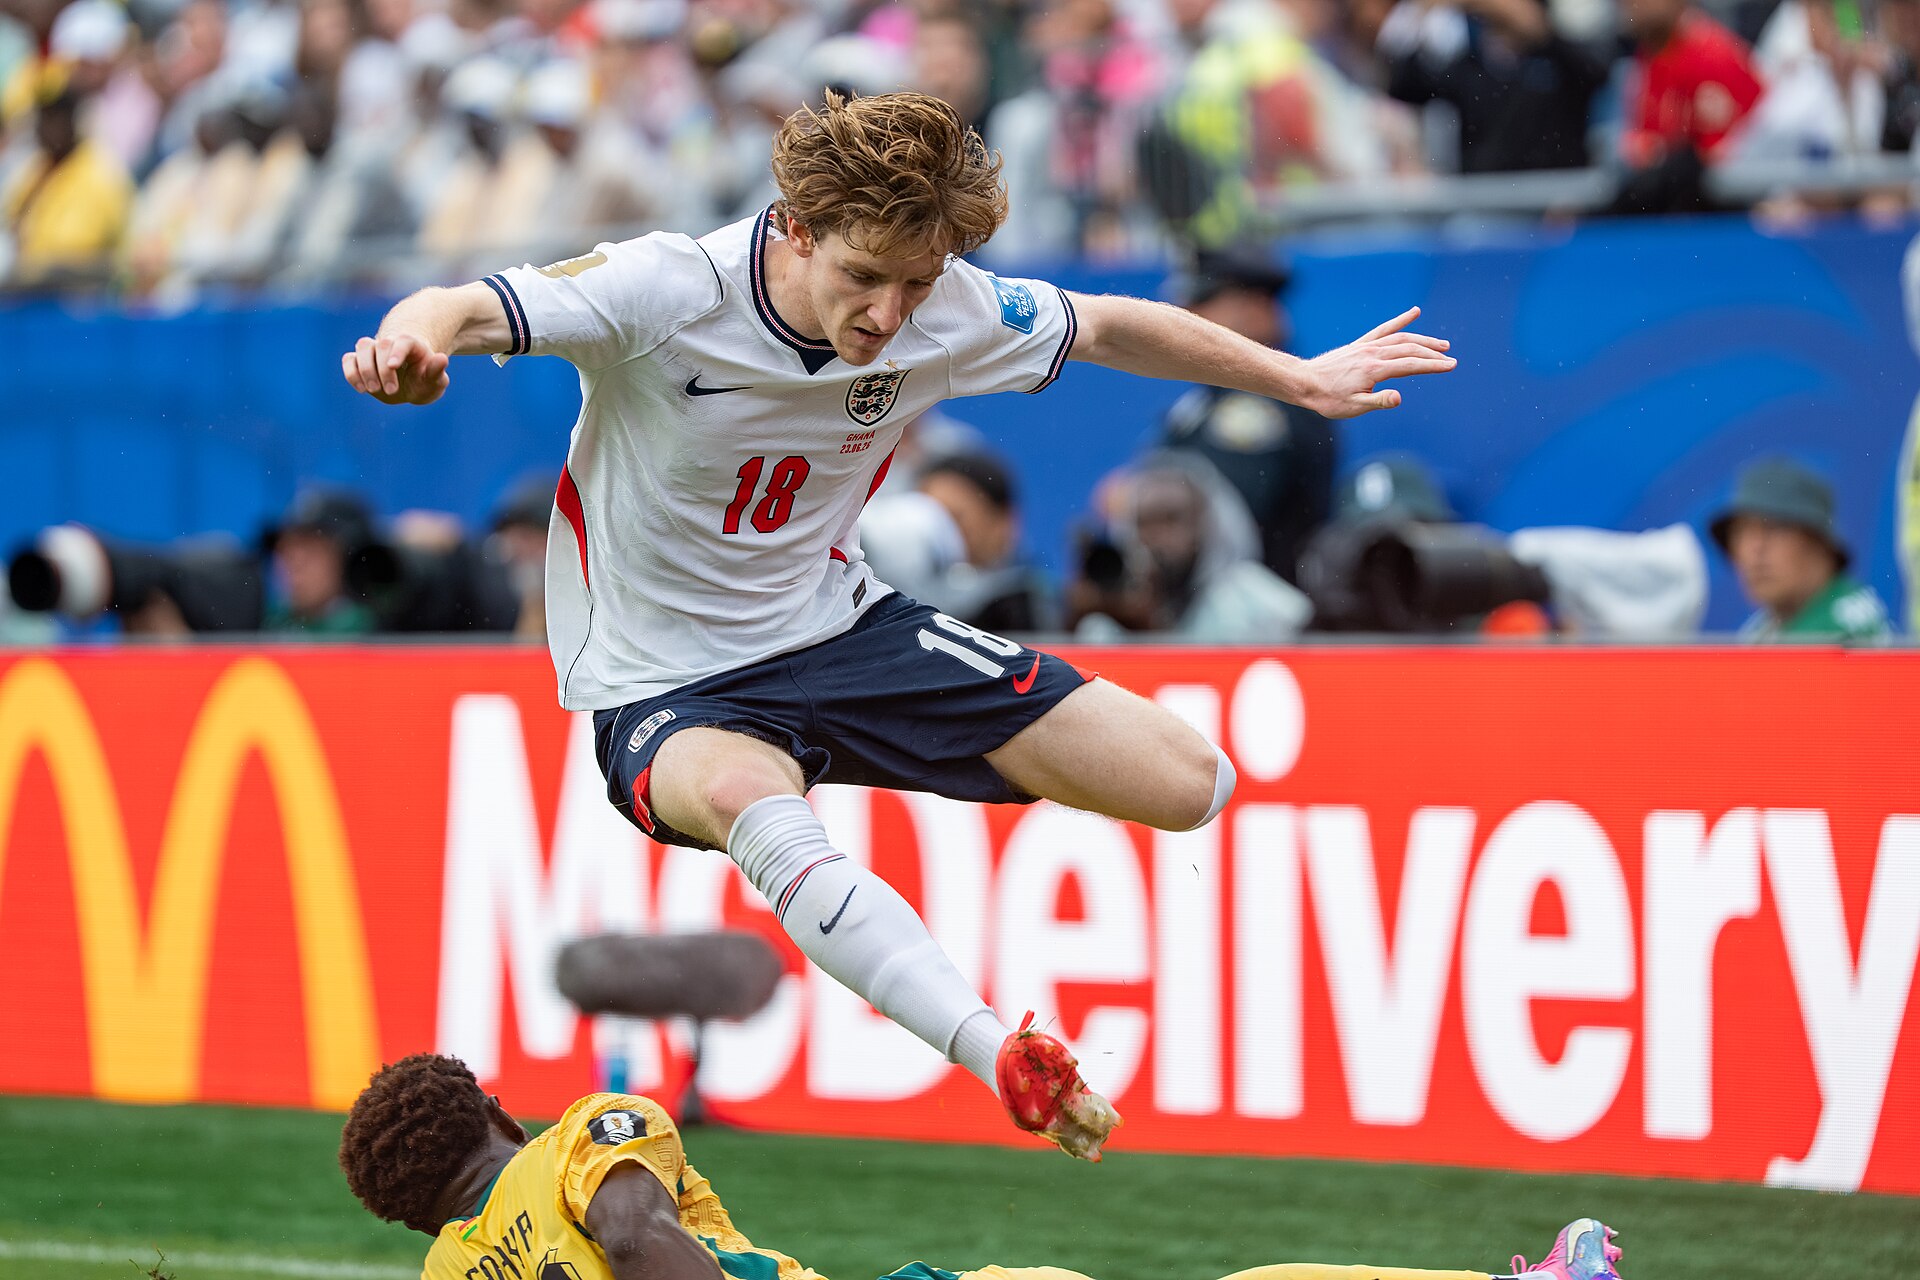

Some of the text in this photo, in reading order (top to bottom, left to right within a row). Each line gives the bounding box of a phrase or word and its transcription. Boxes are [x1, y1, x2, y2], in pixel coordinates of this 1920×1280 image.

[1019, 292, 1030, 316] PEACE
[846, 430, 876, 442] GHANA
[722, 455, 811, 534] 18
[915, 611, 1024, 678] 18
